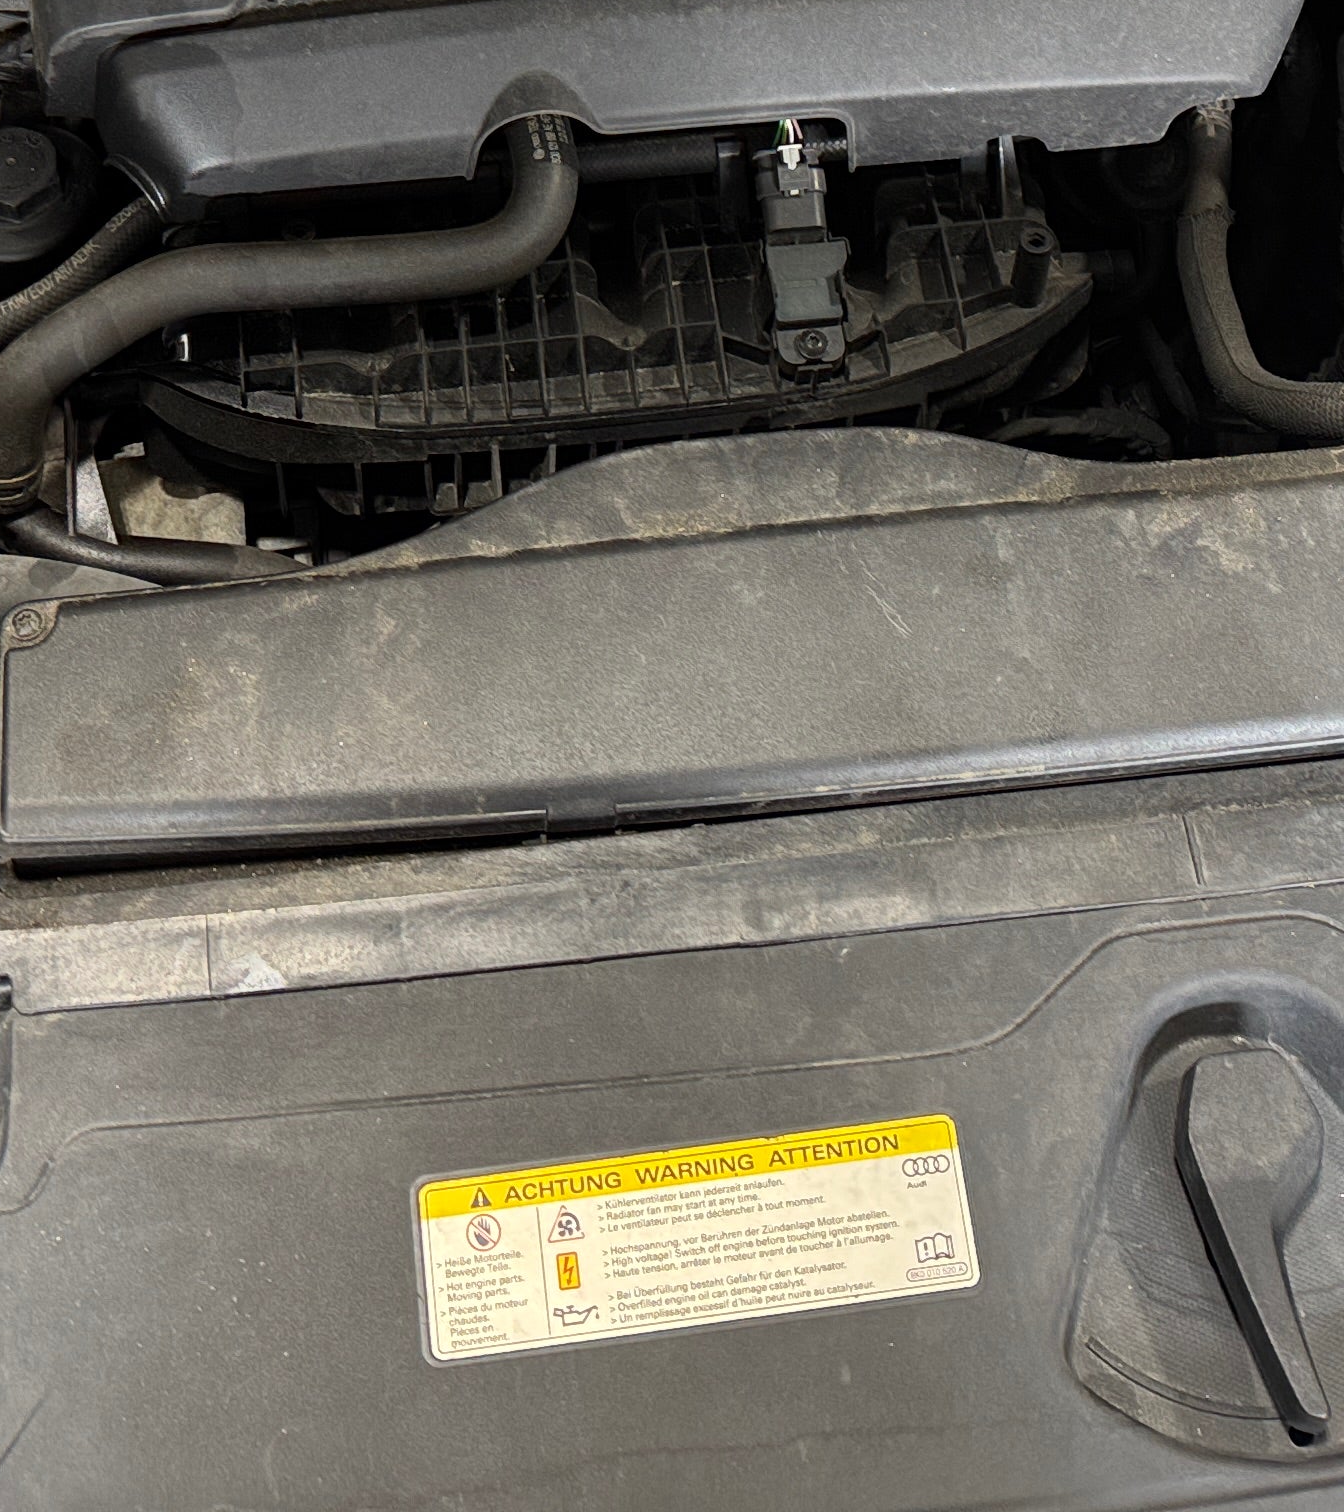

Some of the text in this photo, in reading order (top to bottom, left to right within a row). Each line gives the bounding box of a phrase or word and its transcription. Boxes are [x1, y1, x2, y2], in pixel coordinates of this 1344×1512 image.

[502, 1133, 899, 1203] ACHTUNG WARNING ATTENTION
[906, 1179, 927, 1189] Audi
[604, 1191, 677, 1210] Kühlerventilator
[679, 1188, 701, 1199] kann
[606, 1207, 644, 1221] Radiator
[646, 1205, 661, 1215] fan
[663, 1203, 683, 1215] may
[685, 1199, 705, 1210] start
[707, 1198, 716, 1207] at
[718, 1196, 735, 1207] any
[607, 1222, 618, 1233] Le
[620, 1216, 669, 1231] ventilateur
[671, 1214, 691, 1225] peut
[706, 1204, 755, 1219] déclencher
[764, 1200, 782, 1210] tout
[785, 1194, 825, 1207] moment.
[609, 1236, 681, 1257] Hochspannung,
[682, 1235, 698, 1245] vor
[700, 1228, 742, 1243] Berühren
[744, 1226, 760, 1236] der
[817, 1214, 844, 1226] Motor
[611, 1255, 633, 1268] High
[675, 1245, 705, 1258] Switch
[708, 1243, 721, 1253] off
[722, 1239, 753, 1253] engine
[755, 1235, 785, 1247] before
[786, 1229, 826, 1243] touching
[828, 1225, 862, 1238] ignition
[612, 1266, 639, 1277] Haute
[641, 1261, 678, 1275] tension,
[713, 1255, 721, 1265] le
[723, 1251, 756, 1262] moteur
[758, 1247, 783, 1258] avant
[785, 1244, 797, 1254] de
[799, 1239, 834, 1252] toucher
[444, 1264, 485, 1280] Bewegte
[446, 1282, 463, 1292] Hot
[465, 1278, 496, 1291] engine
[616, 1289, 631, 1300] Bei
[690, 1276, 724, 1289] besteht
[726, 1271, 757, 1285] Gefahr
[758, 1269, 773, 1280] für
[774, 1267, 791, 1278] den
[447, 1290, 482, 1304] Moving
[480, 1302, 492, 1311] du
[494, 1298, 528, 1309] moteur
[617, 1297, 662, 1311] Overfilled
[664, 1293, 696, 1306] engine
[697, 1290, 709, 1300] oil
[711, 1289, 728, 1298] can
[730, 1282, 767, 1297] damage
[618, 1313, 633, 1323] Un
[635, 1305, 691, 1322] remplissage
[692, 1299, 729, 1313] excessif
[764, 1292, 785, 1304] peut
[787, 1289, 811, 1299] nuire
[813, 1287, 825, 1296] au
[481, 1325, 494, 1333] en
